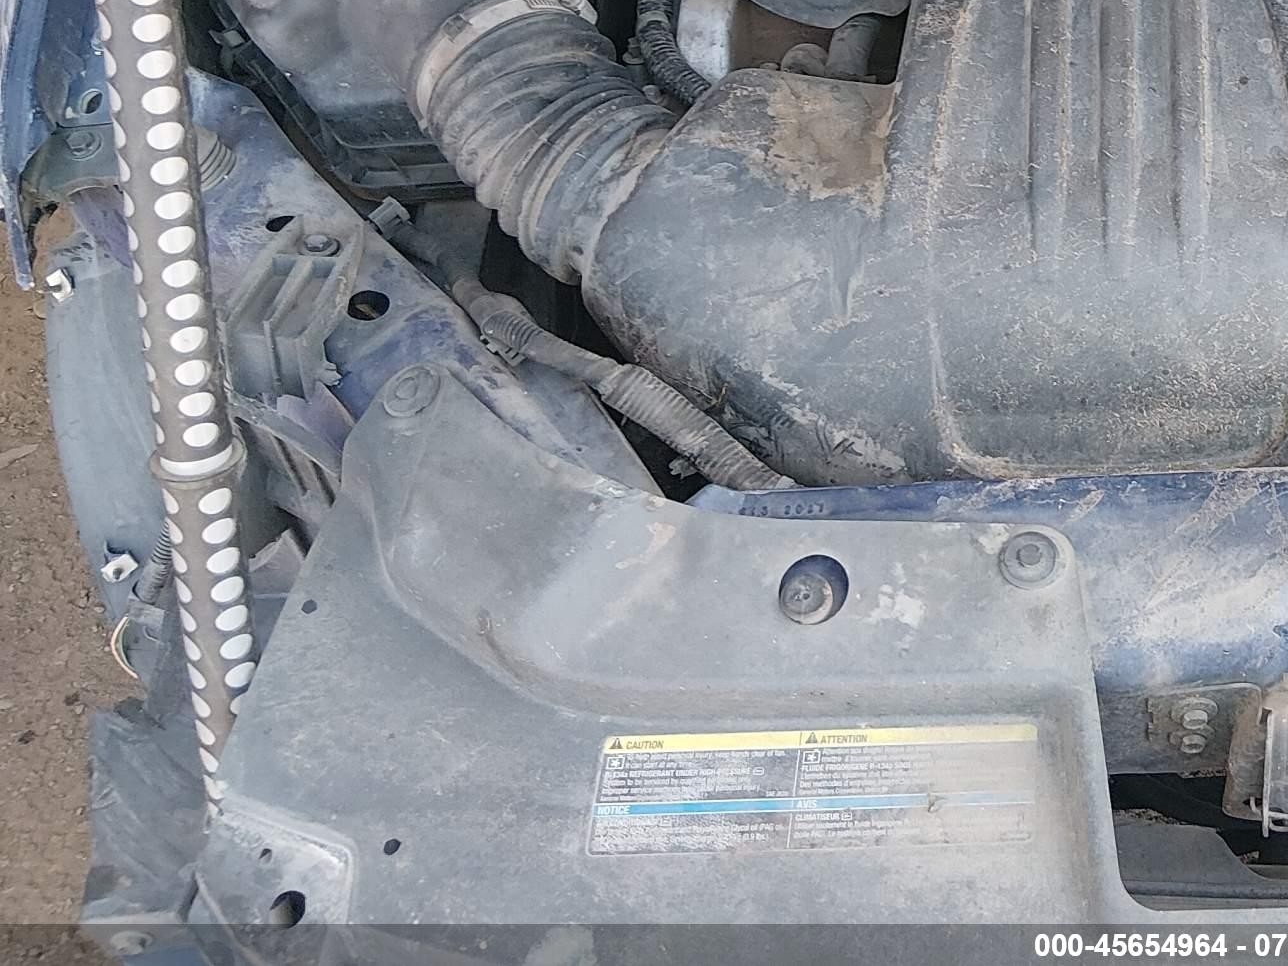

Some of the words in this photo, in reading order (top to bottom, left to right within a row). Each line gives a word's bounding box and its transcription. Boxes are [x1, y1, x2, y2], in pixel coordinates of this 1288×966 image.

[820, 733, 868, 744] ATTENTION
[626, 740, 664, 750] CAUTION
[796, 799, 816, 808] AVIS
[597, 804, 630, 815] NOTICE
[794, 812, 839, 822] CLIMATISEUR
